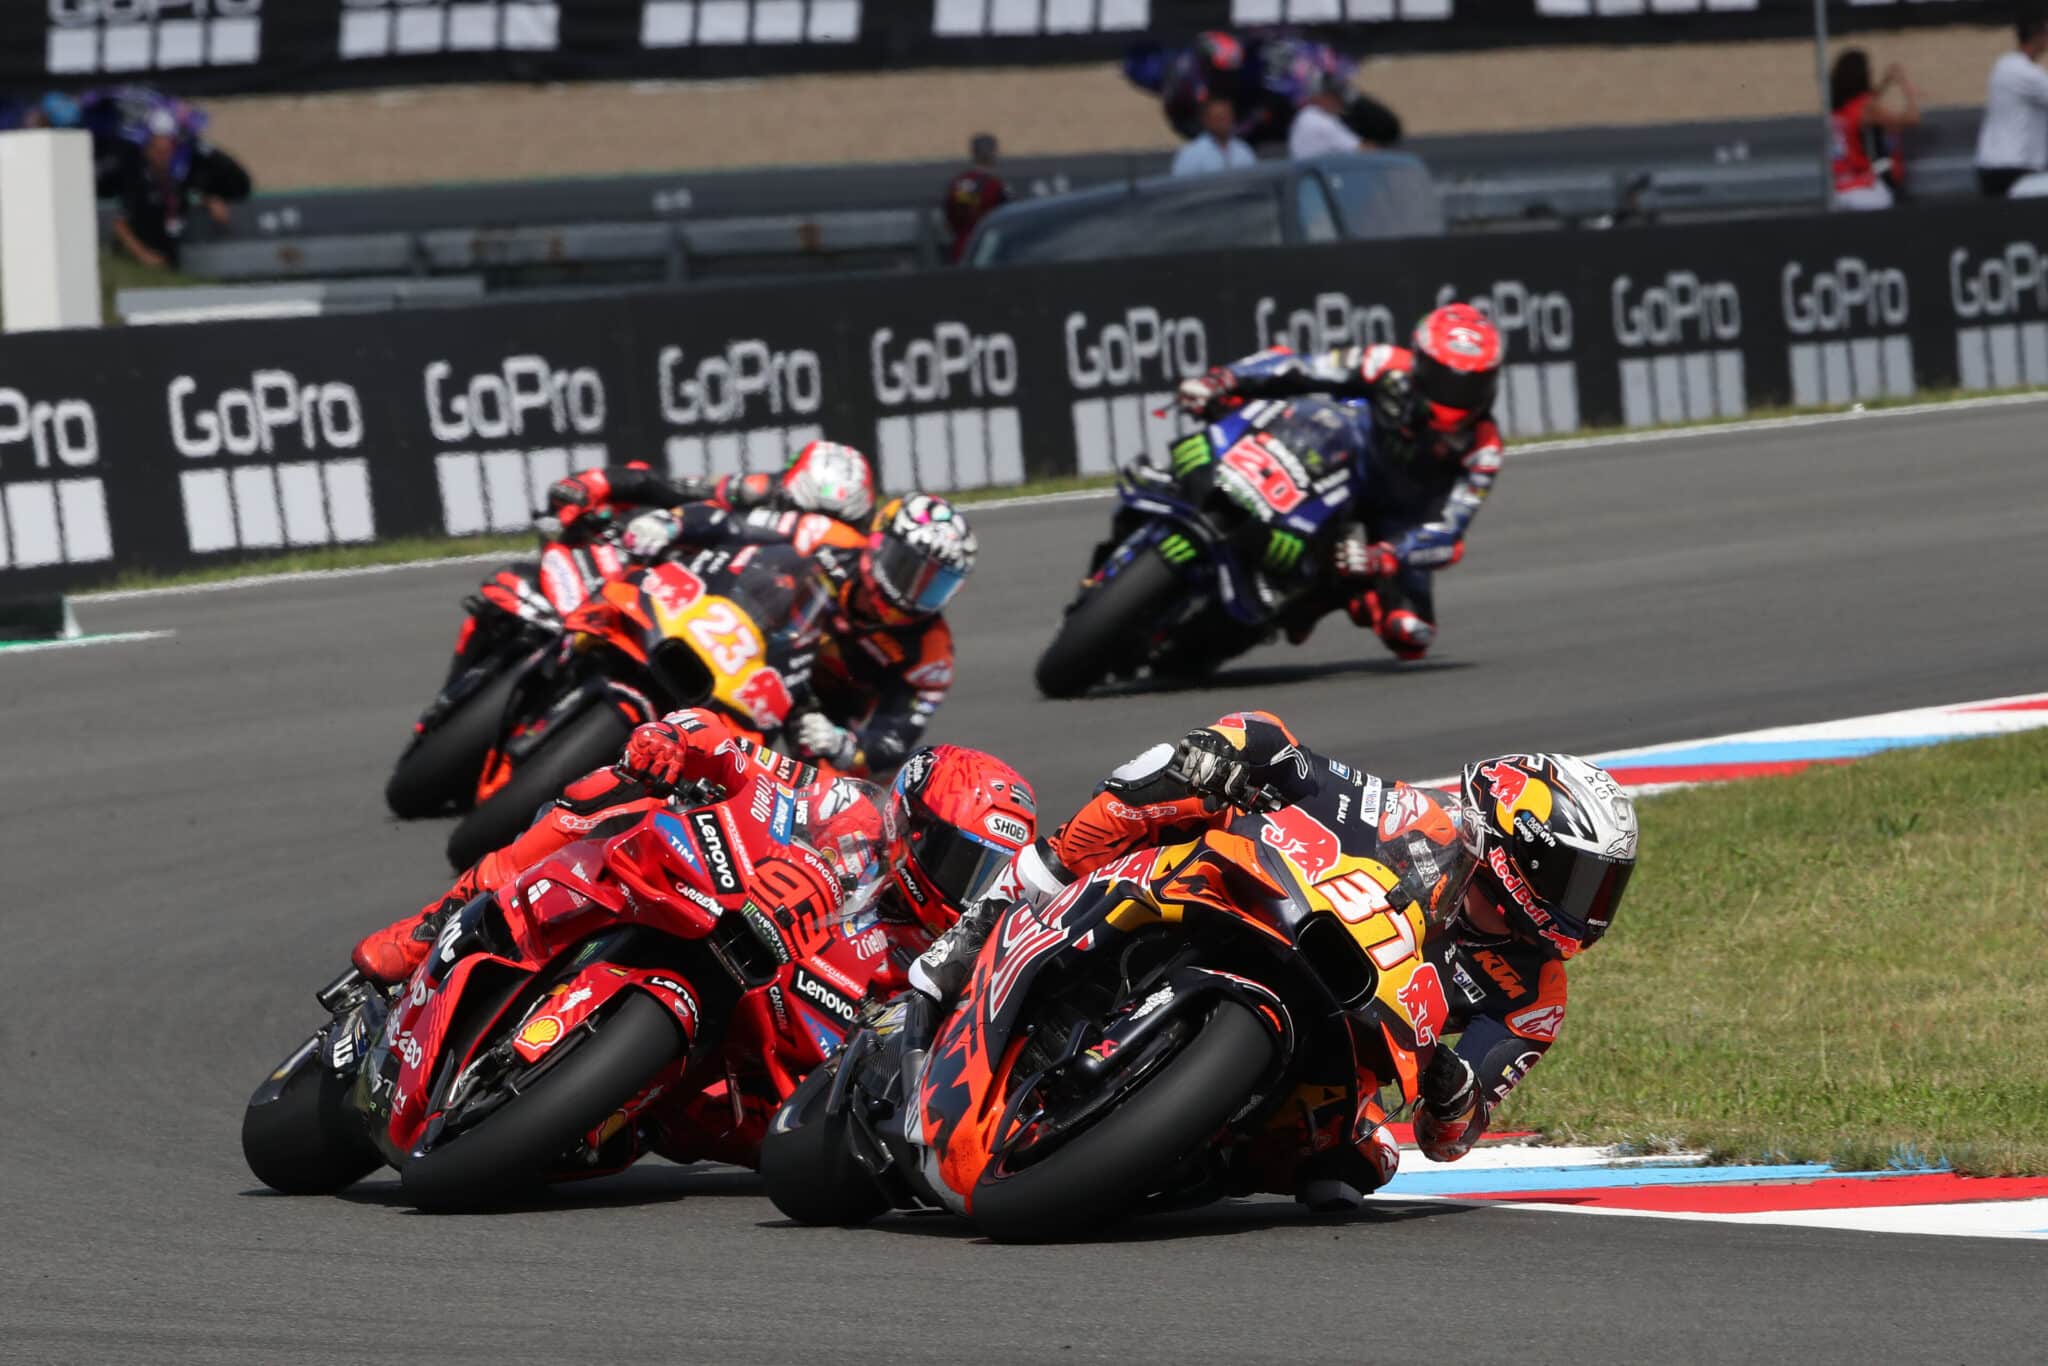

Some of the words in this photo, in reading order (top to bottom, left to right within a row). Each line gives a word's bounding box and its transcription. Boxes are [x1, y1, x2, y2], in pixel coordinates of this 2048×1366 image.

[1437, 281, 1573, 351] Pro
[1611, 270, 1742, 347] GoPro
[1780, 257, 1908, 335] GoPro
[1949, 241, 2048, 317] GoPr
[659, 339, 822, 425] GoPro
[871, 322, 1018, 404] GoPro
[1065, 306, 1208, 389] GoPro
[0, 387, 100, 467] Pro
[167, 369, 363, 457] GoPro
[424, 354, 606, 442] GoPro
[1222, 434, 1307, 513] 20
[686, 602, 759, 675] 23
[671, 835, 695, 864] TIM
[695, 813, 735, 889] Lenovo
[993, 816, 1026, 840] SHOEI
[675, 882, 724, 917] CARRERA
[1488, 847, 1522, 893] Red
[1512, 882, 1552, 927] Bull
[796, 970, 854, 1021] Lenovo
[1472, 950, 1528, 1000] KTM
